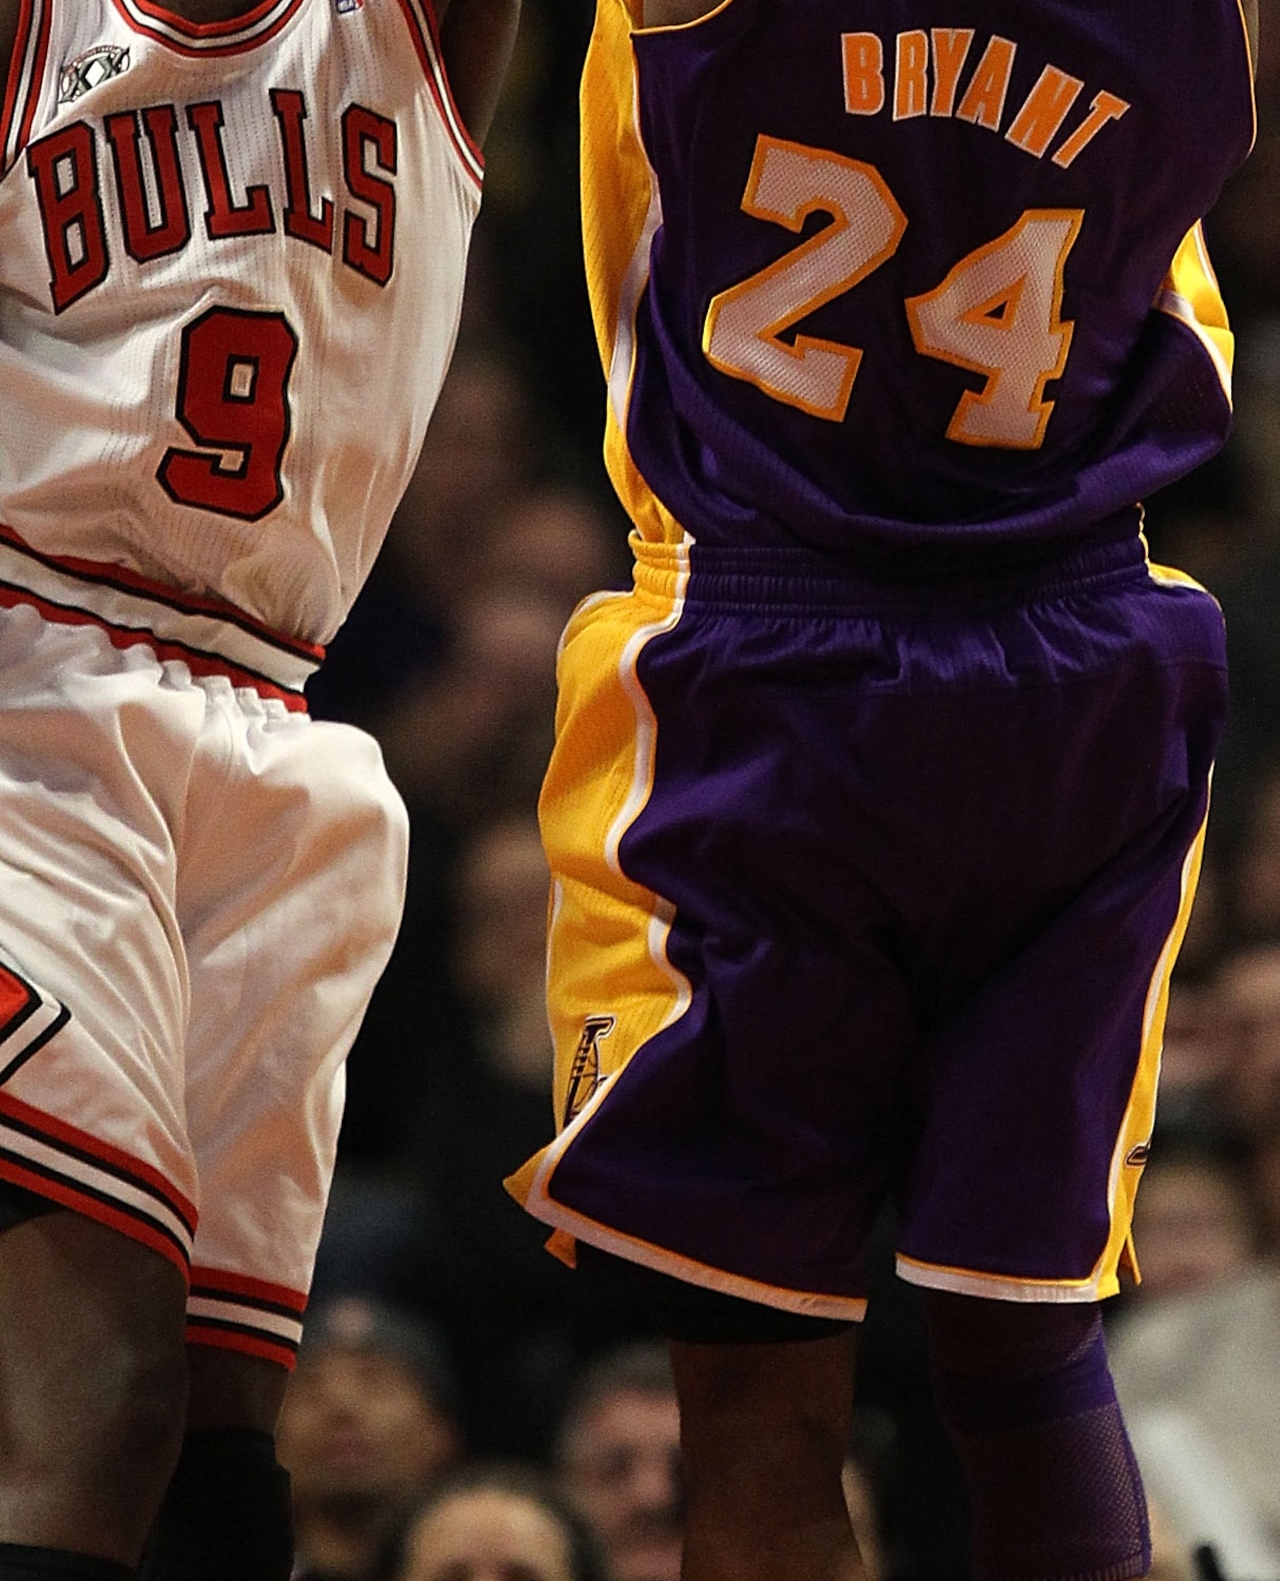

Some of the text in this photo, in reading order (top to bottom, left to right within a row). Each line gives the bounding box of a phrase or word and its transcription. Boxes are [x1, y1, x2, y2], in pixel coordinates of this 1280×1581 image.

[27, 88, 398, 316] BULLS
[840, 27, 1131, 169] BRYANT
[702, 133, 1086, 450] 24
[155, 305, 299, 522] 9
